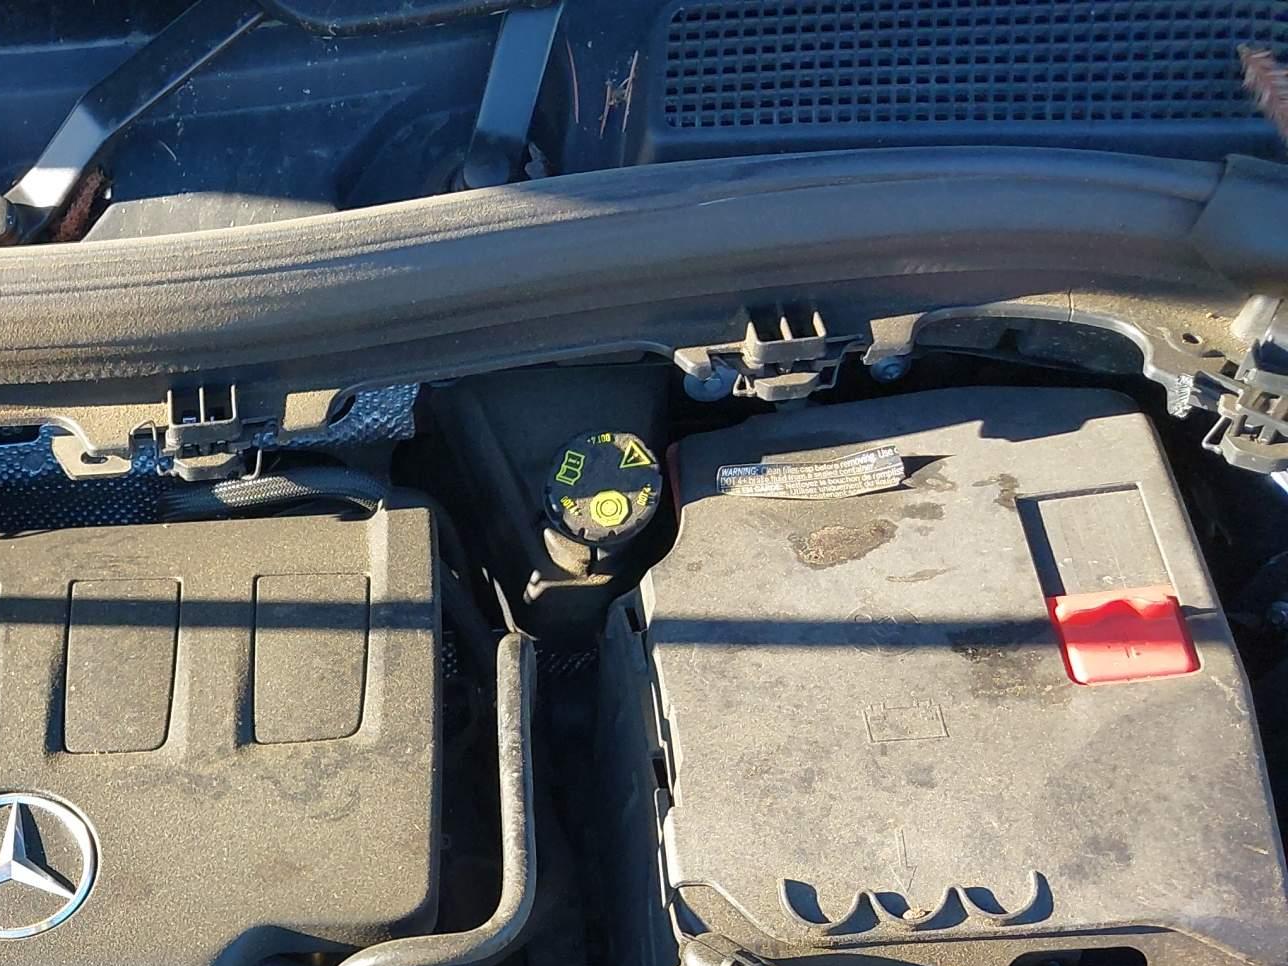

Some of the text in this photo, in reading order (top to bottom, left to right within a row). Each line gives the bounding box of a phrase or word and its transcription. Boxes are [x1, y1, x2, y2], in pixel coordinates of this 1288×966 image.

[721, 467, 759, 477] WARNING:
[877, 448, 894, 458] Use
[720, 477, 735, 485] DOT
